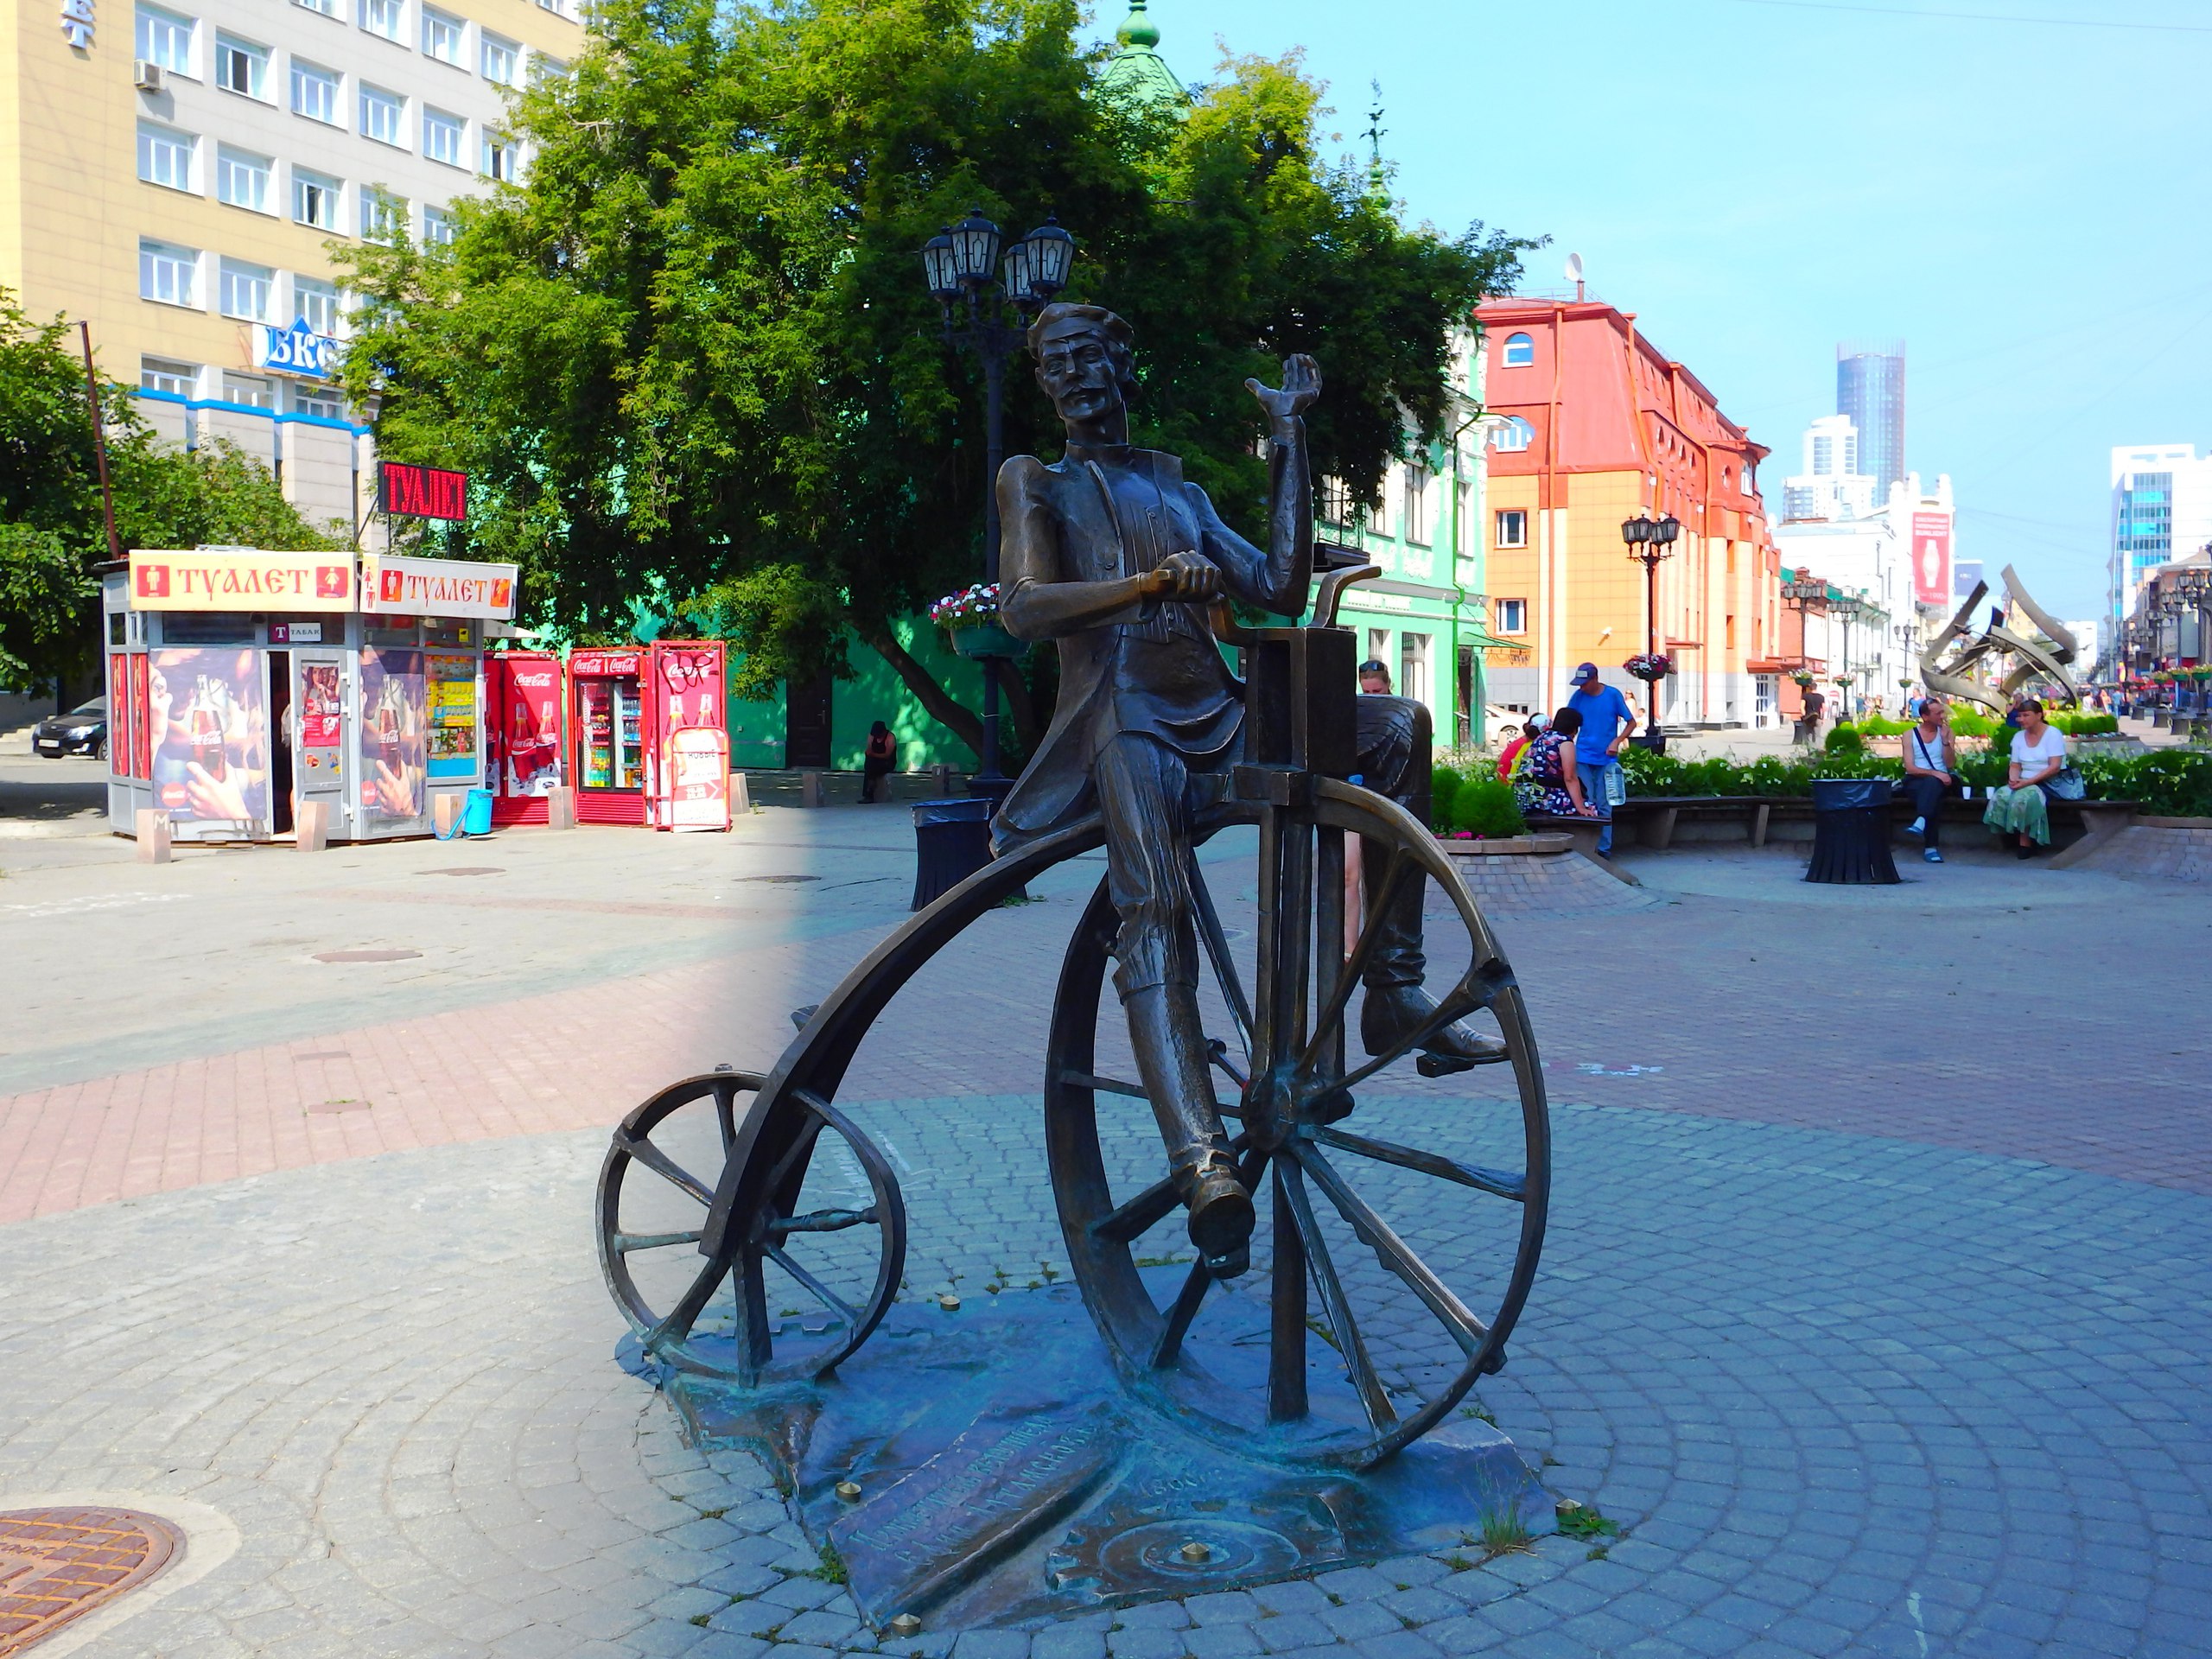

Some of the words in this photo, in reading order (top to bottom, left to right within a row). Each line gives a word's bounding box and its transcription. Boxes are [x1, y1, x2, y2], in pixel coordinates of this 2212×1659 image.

[385, 463, 466, 520] ТУАЛЕТ
[177, 569, 308, 601] ТУАЛЕТ
[408, 575, 487, 607] ТУАЛЕТ
